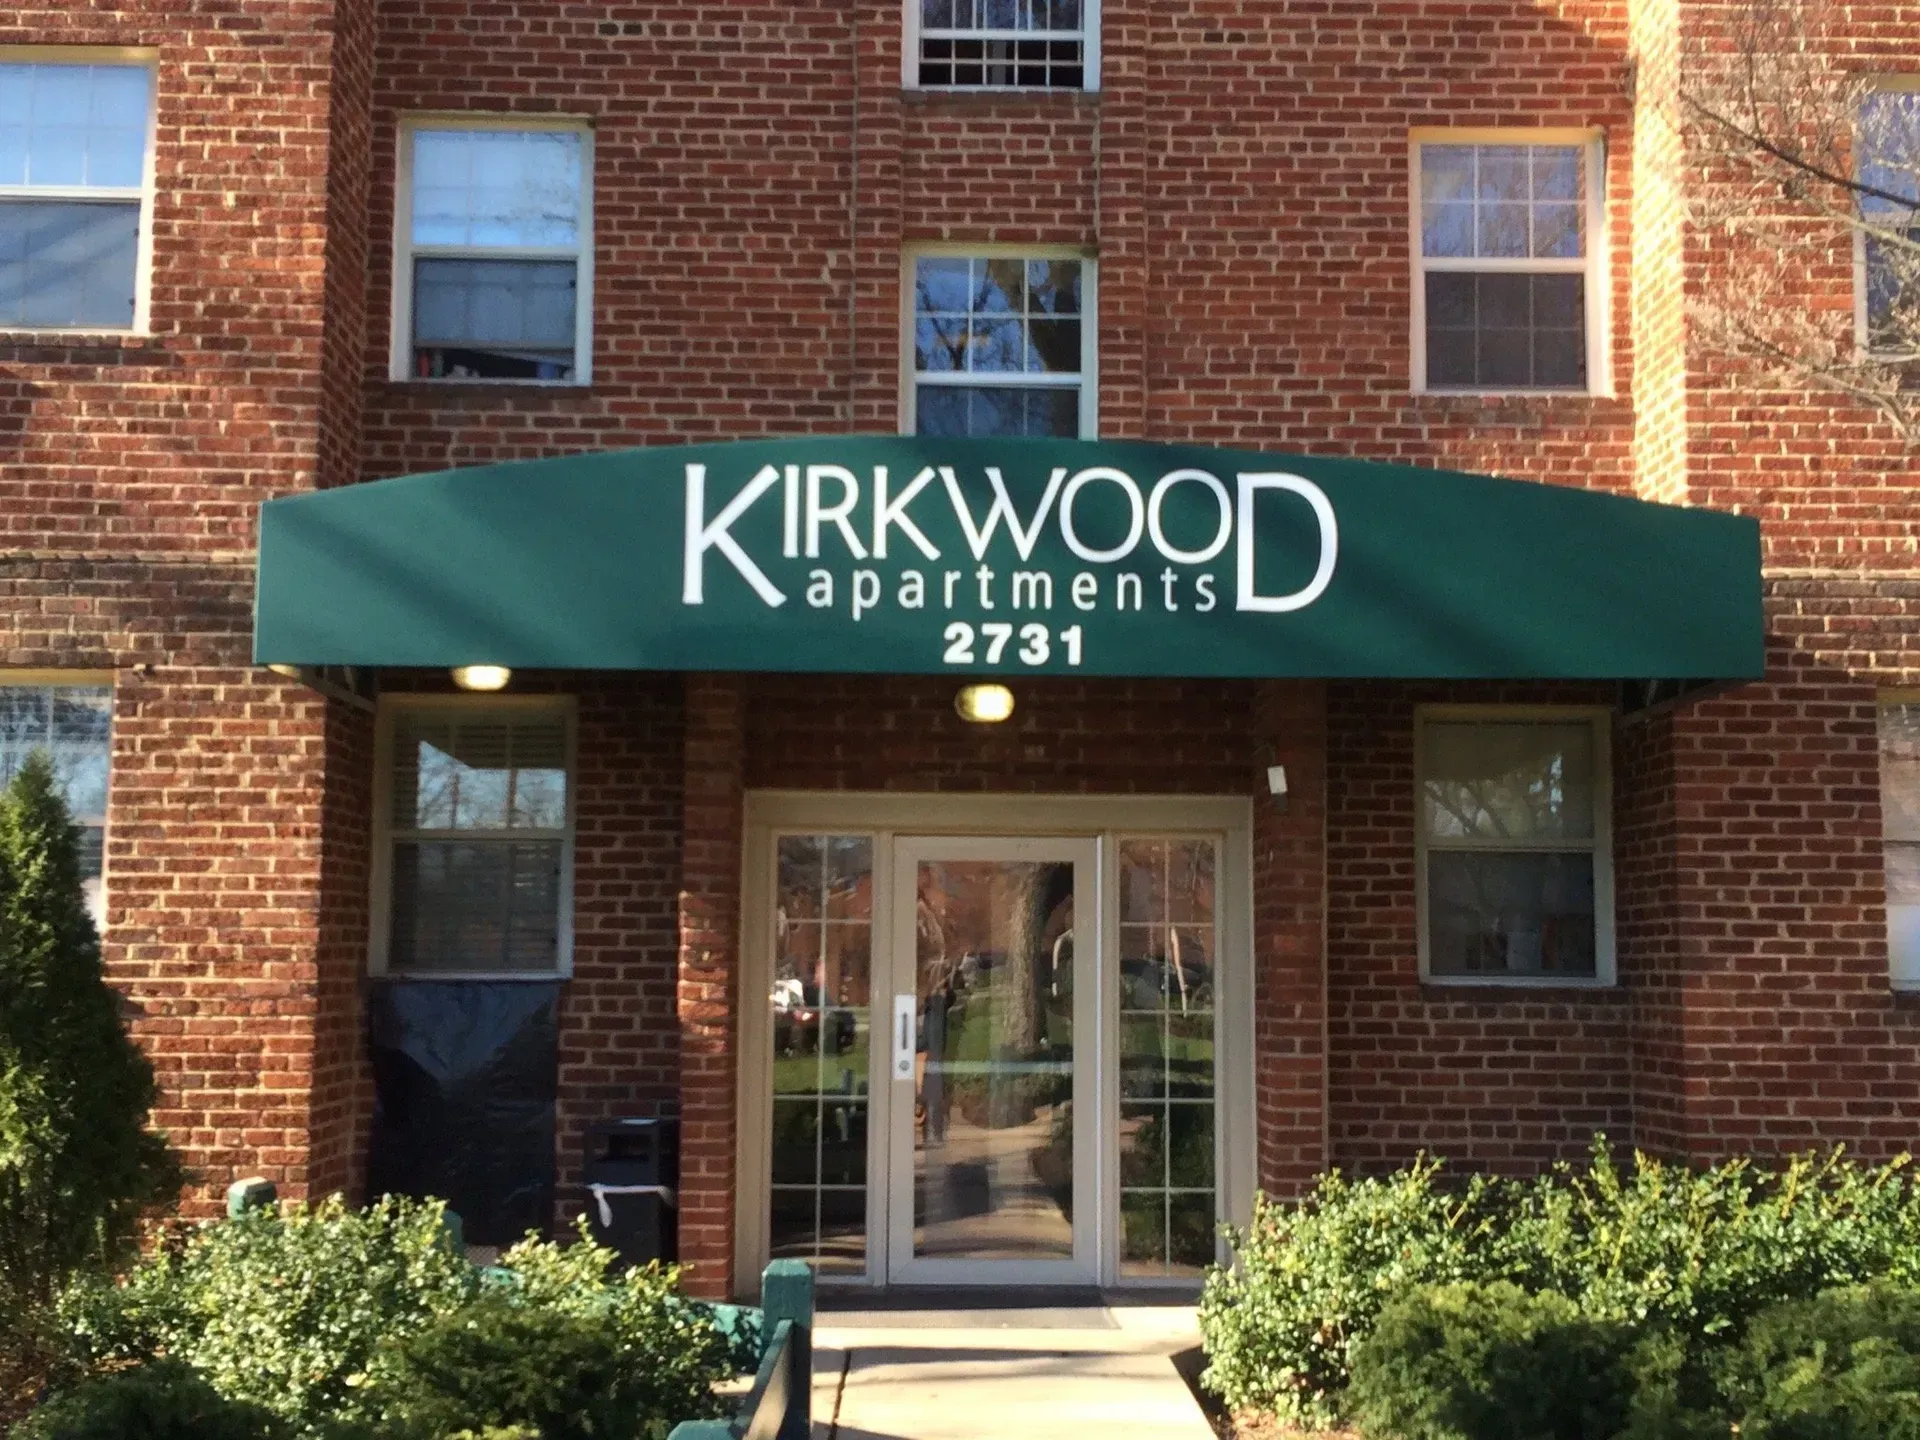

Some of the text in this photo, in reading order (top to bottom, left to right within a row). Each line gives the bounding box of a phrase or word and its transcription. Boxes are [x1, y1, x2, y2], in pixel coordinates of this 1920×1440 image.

[682, 463, 1339, 613] KIRKWOOD
[806, 564, 1217, 621] apartments
[943, 621, 1083, 666] 2731
